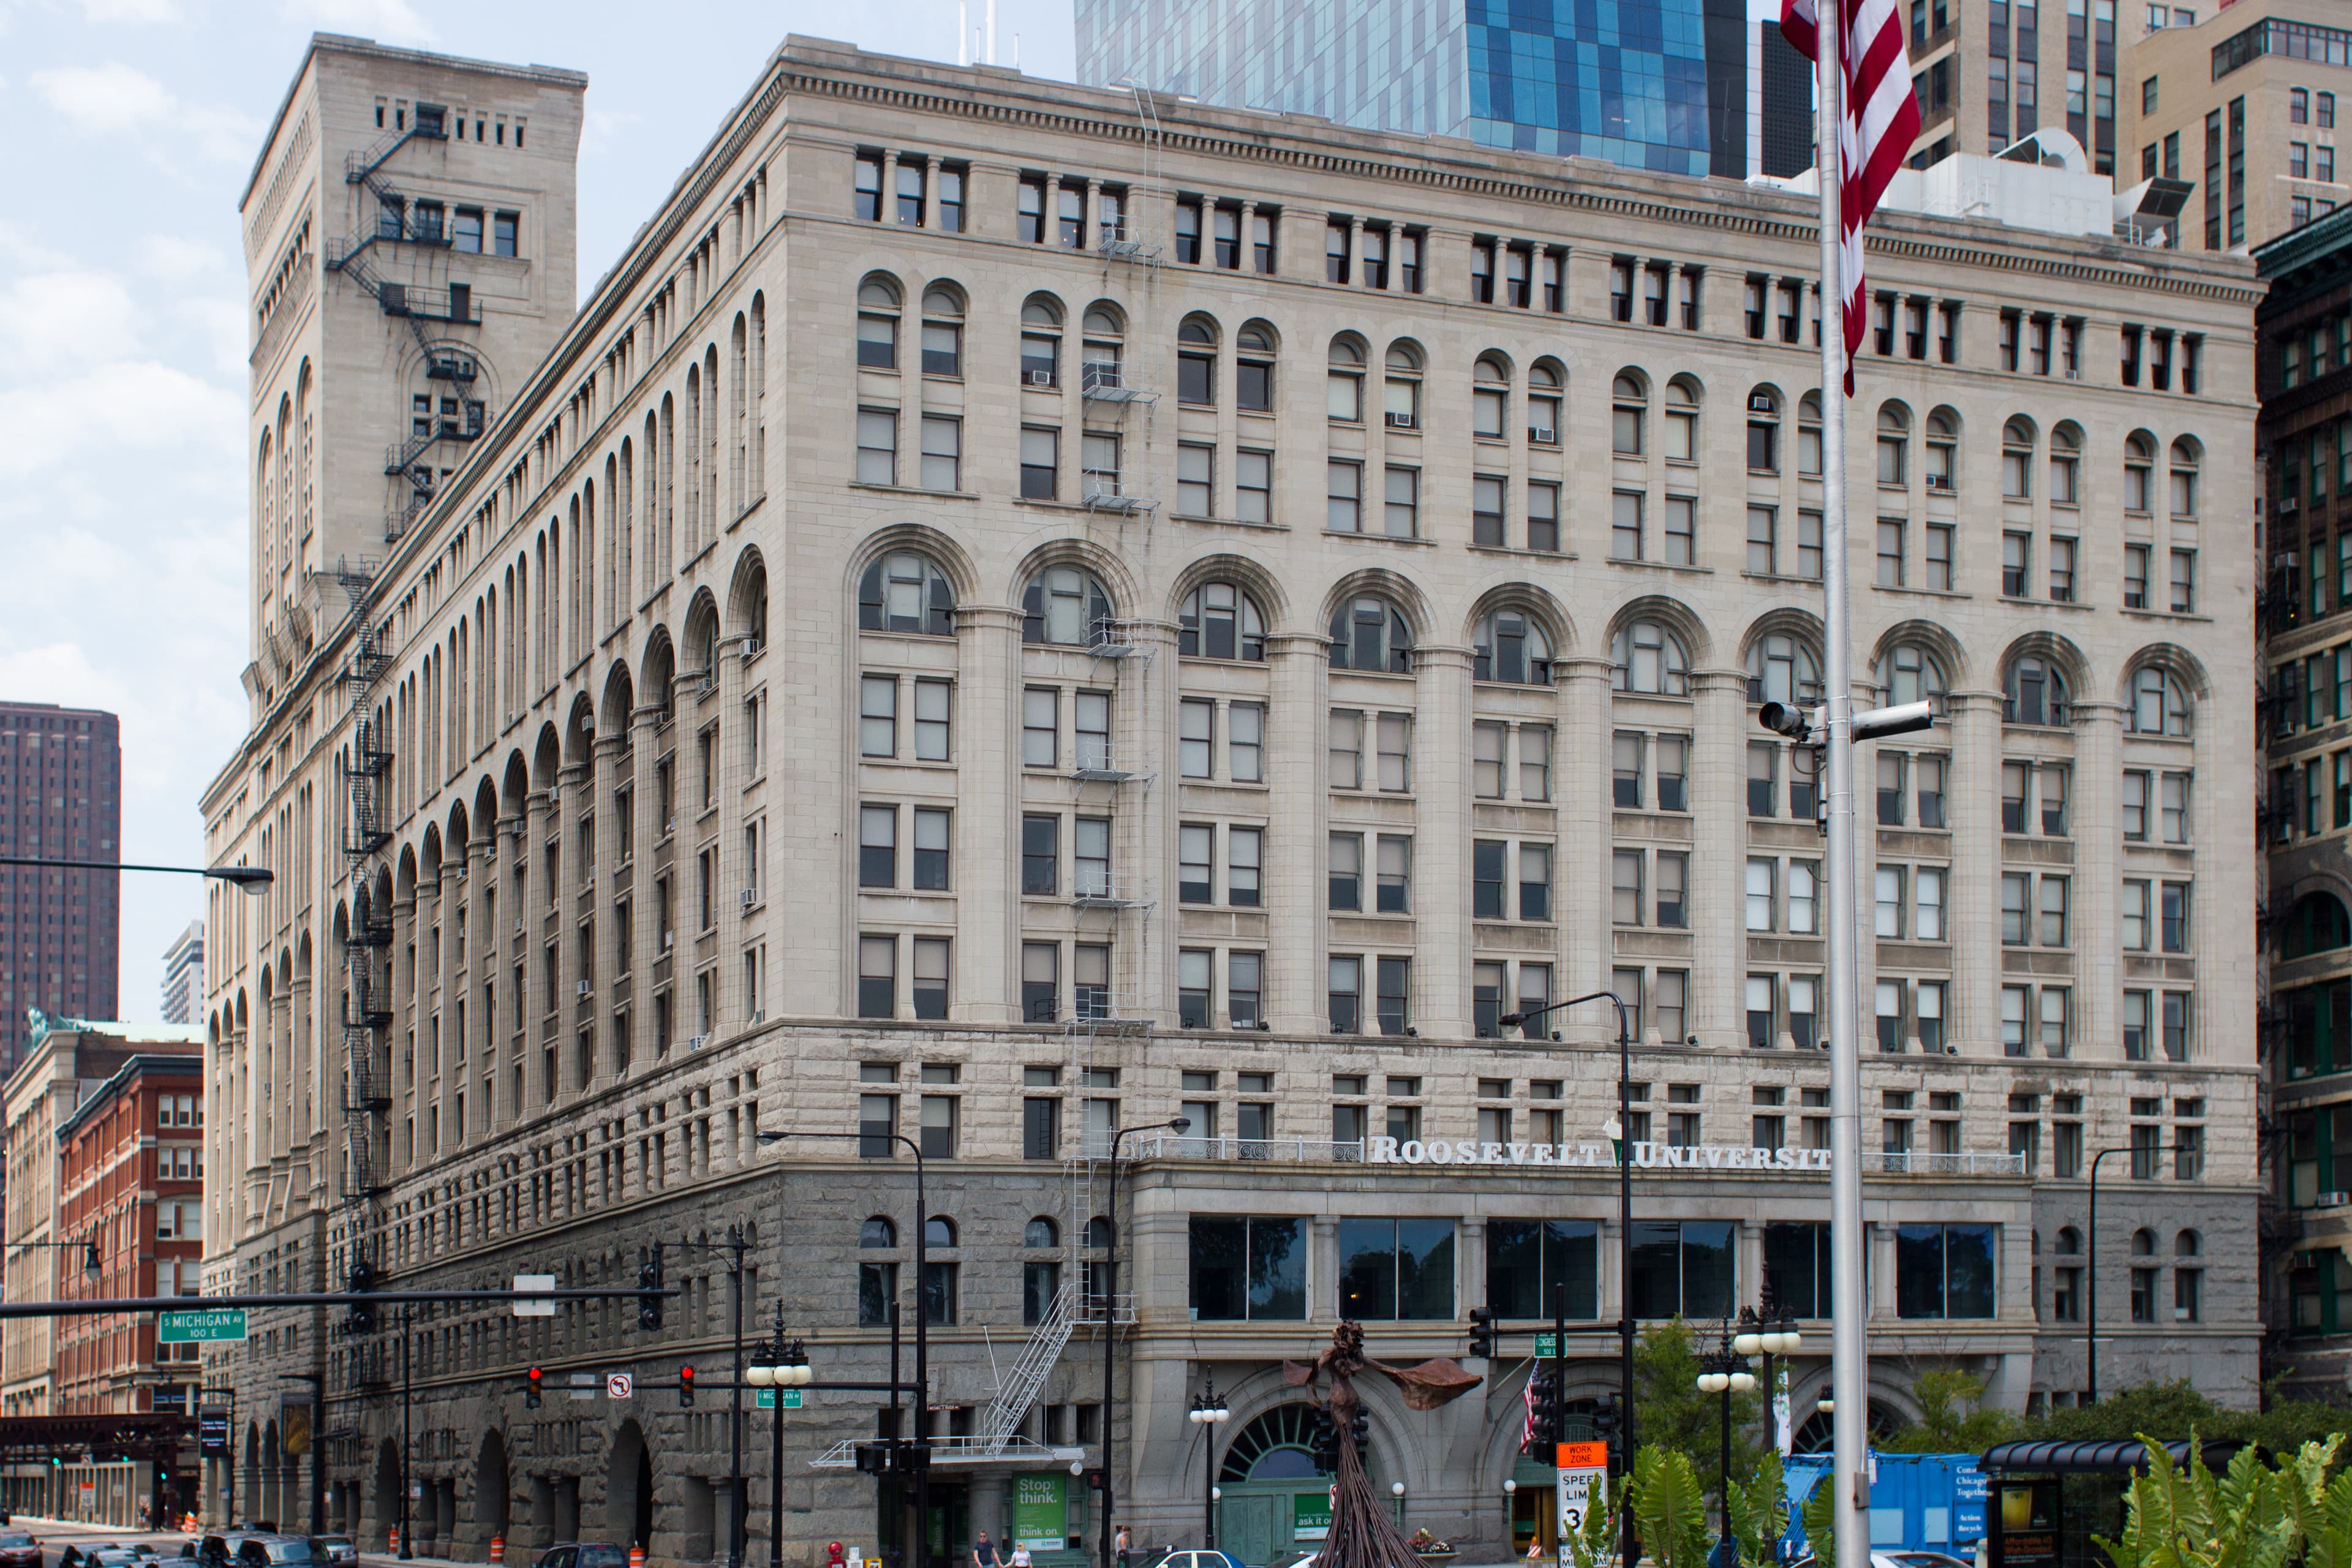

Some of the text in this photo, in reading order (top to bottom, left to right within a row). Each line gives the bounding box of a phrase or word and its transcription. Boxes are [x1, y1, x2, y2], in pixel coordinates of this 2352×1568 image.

[1371, 1136, 1832, 1170] ROOSEVELT UNIVERSIT
[164, 1318, 170, 1327] S
[172, 1314, 230, 1328] MICHIGAN
[190, 1329, 217, 1338] 100 E
[763, 1392, 793, 1400] MICAN
[1569, 1445, 1593, 1454] WORK
[1570, 1455, 1593, 1463] ZONE
[1019, 1478, 1051, 1493] Stop
[1956, 1476, 1987, 1488] Chicago
[1019, 1491, 1058, 1504] think.
[1566, 1490, 1588, 1501] LIM
[1298, 1517, 1313, 1526] ask
[1316, 1517, 1322, 1525] it
[1019, 1527, 1042, 1537] think
